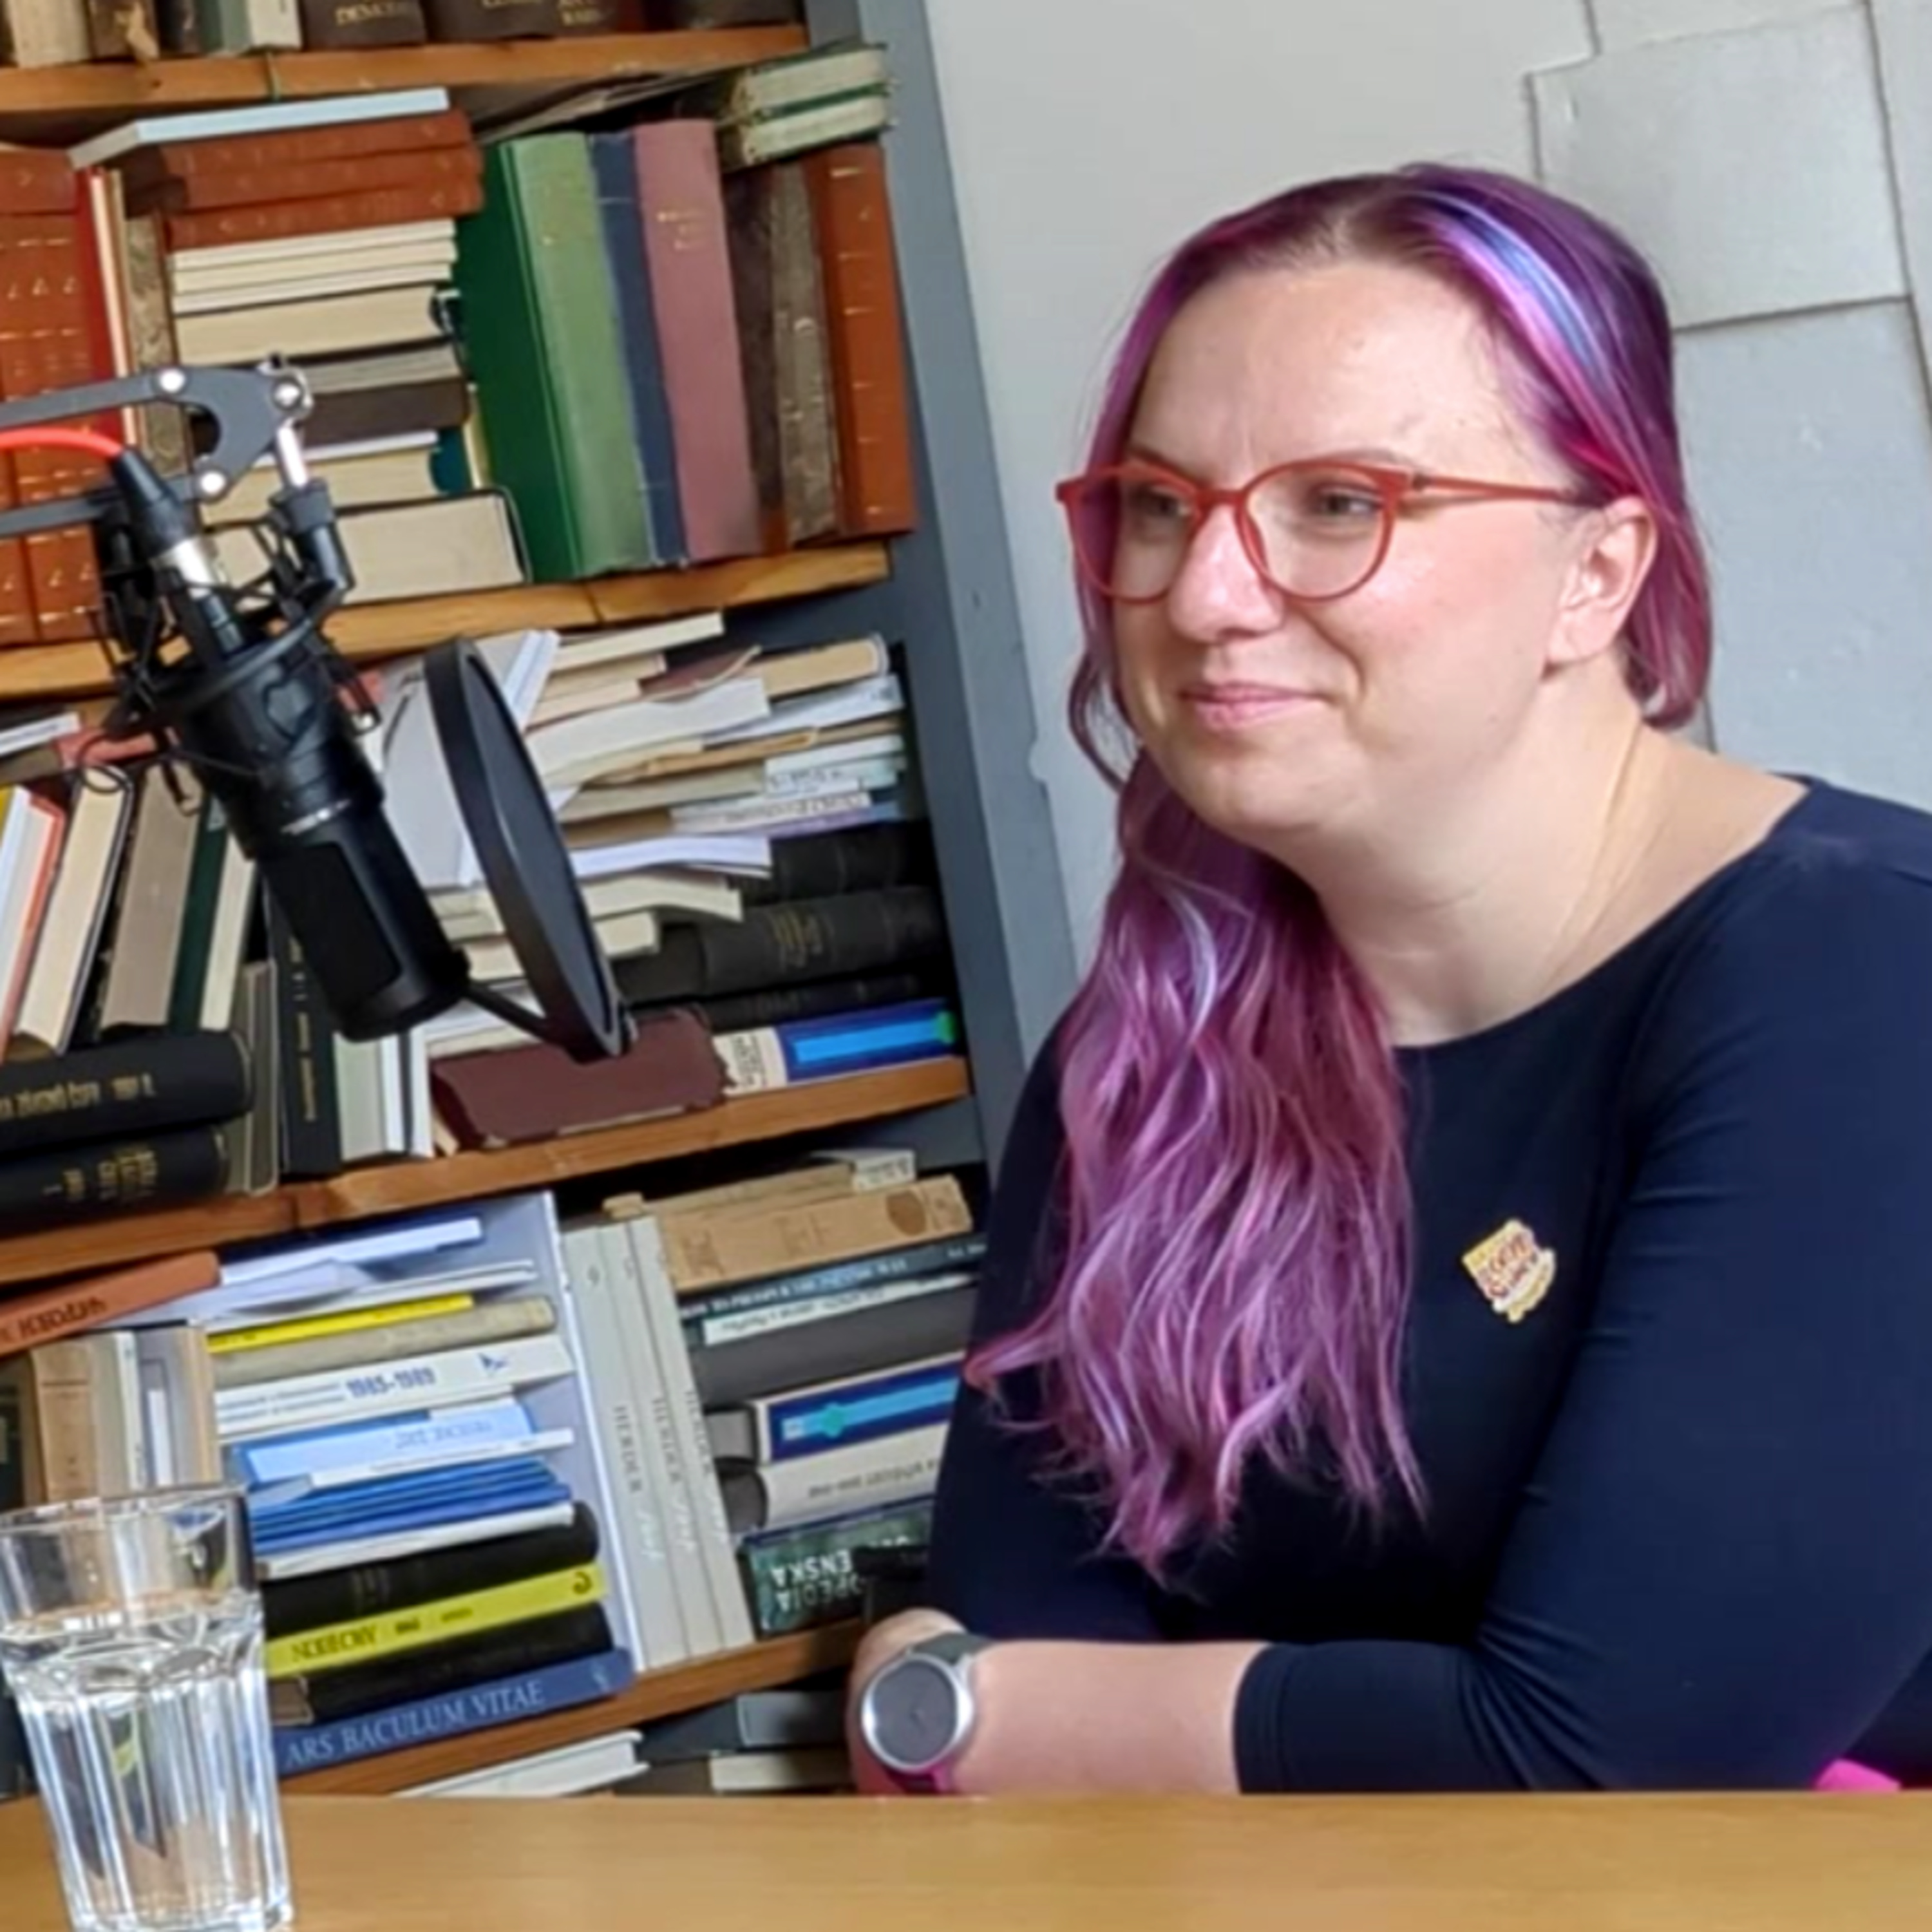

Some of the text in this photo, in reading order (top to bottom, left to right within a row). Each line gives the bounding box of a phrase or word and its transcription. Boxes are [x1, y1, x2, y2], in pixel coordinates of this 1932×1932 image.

[284, 1678, 545, 1768] ARS BACULUM VITAE
